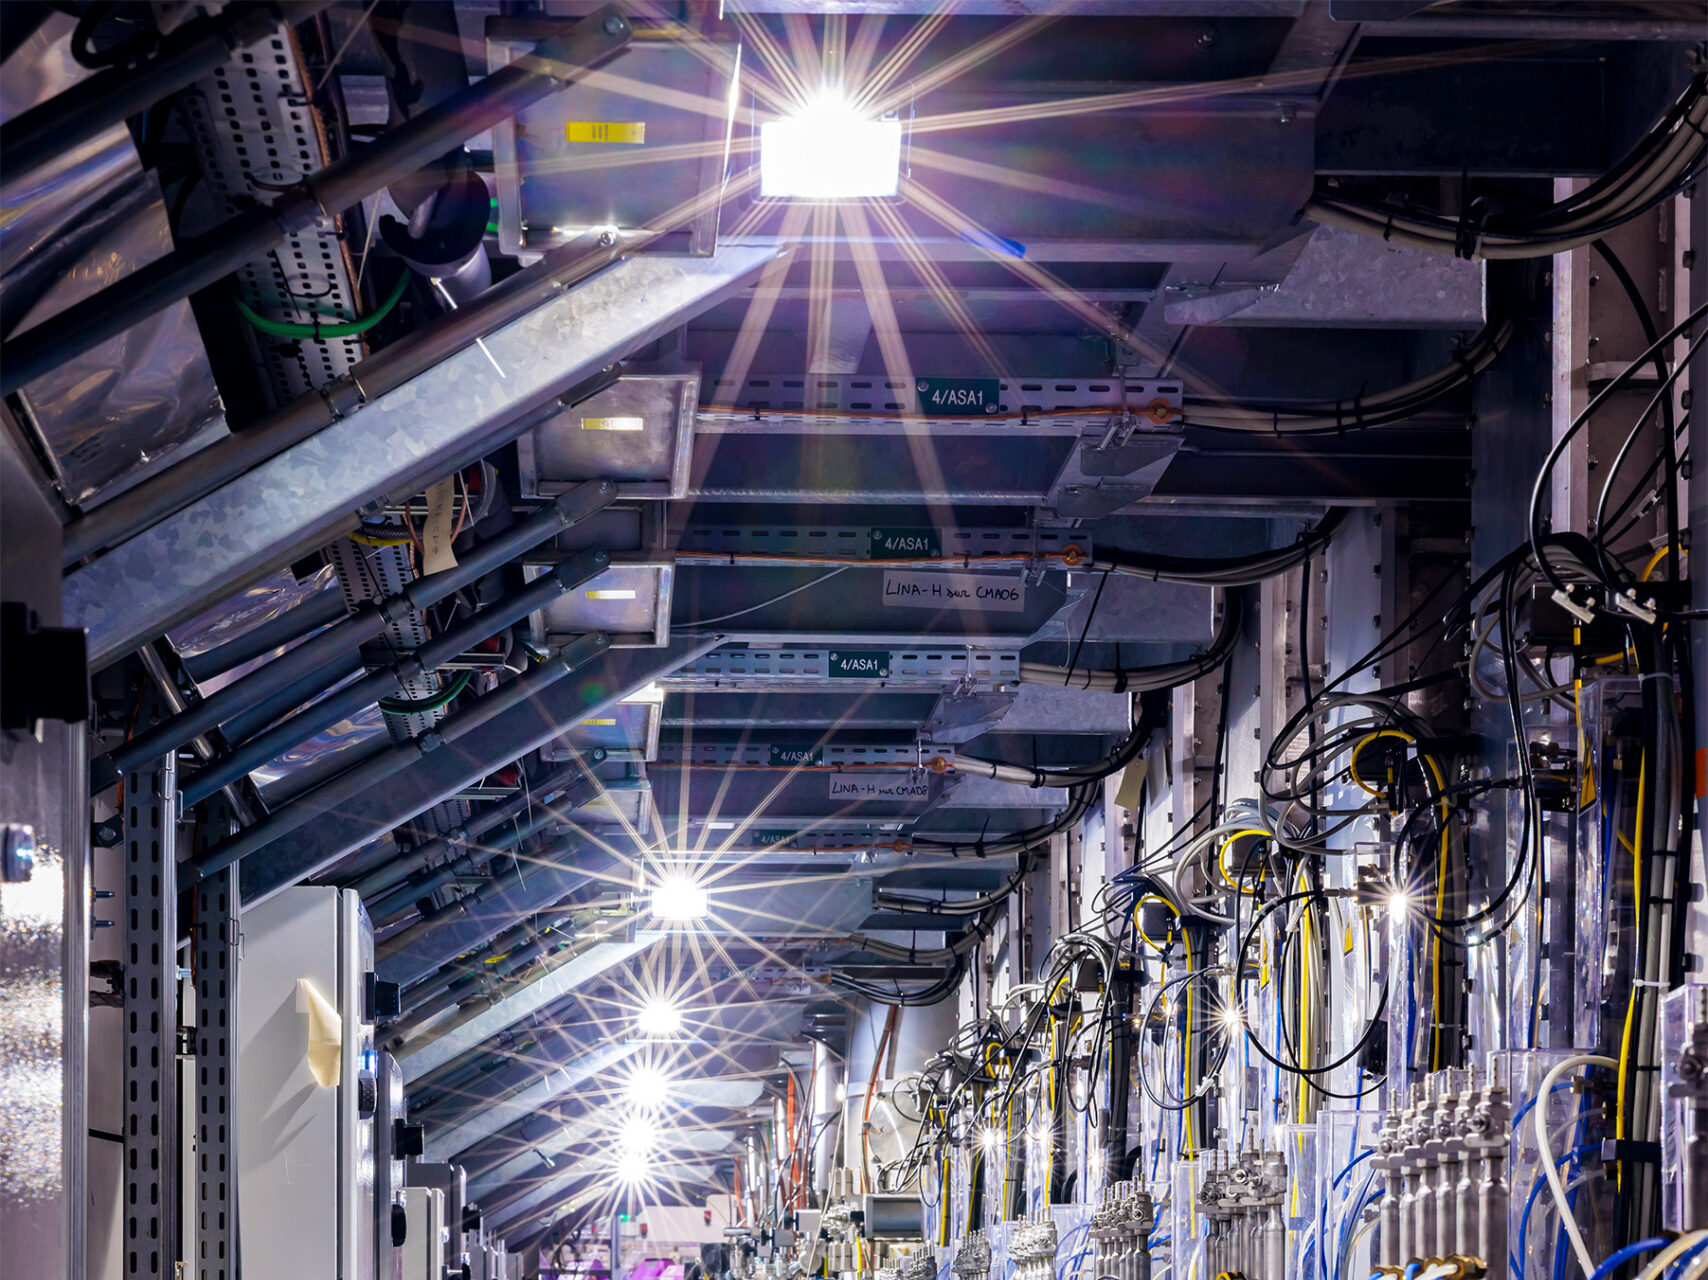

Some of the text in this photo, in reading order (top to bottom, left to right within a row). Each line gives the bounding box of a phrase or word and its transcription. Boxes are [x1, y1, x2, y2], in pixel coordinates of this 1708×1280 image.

[931, 388, 984, 406] 4/ASA1
[884, 536, 930, 552] 4/ASA1
[946, 588, 971, 598] sur
[976, 586, 1020, 601] CMA06
[840, 658, 878, 671] 4/ASA1
[780, 750, 814, 762] 4/ASA1
